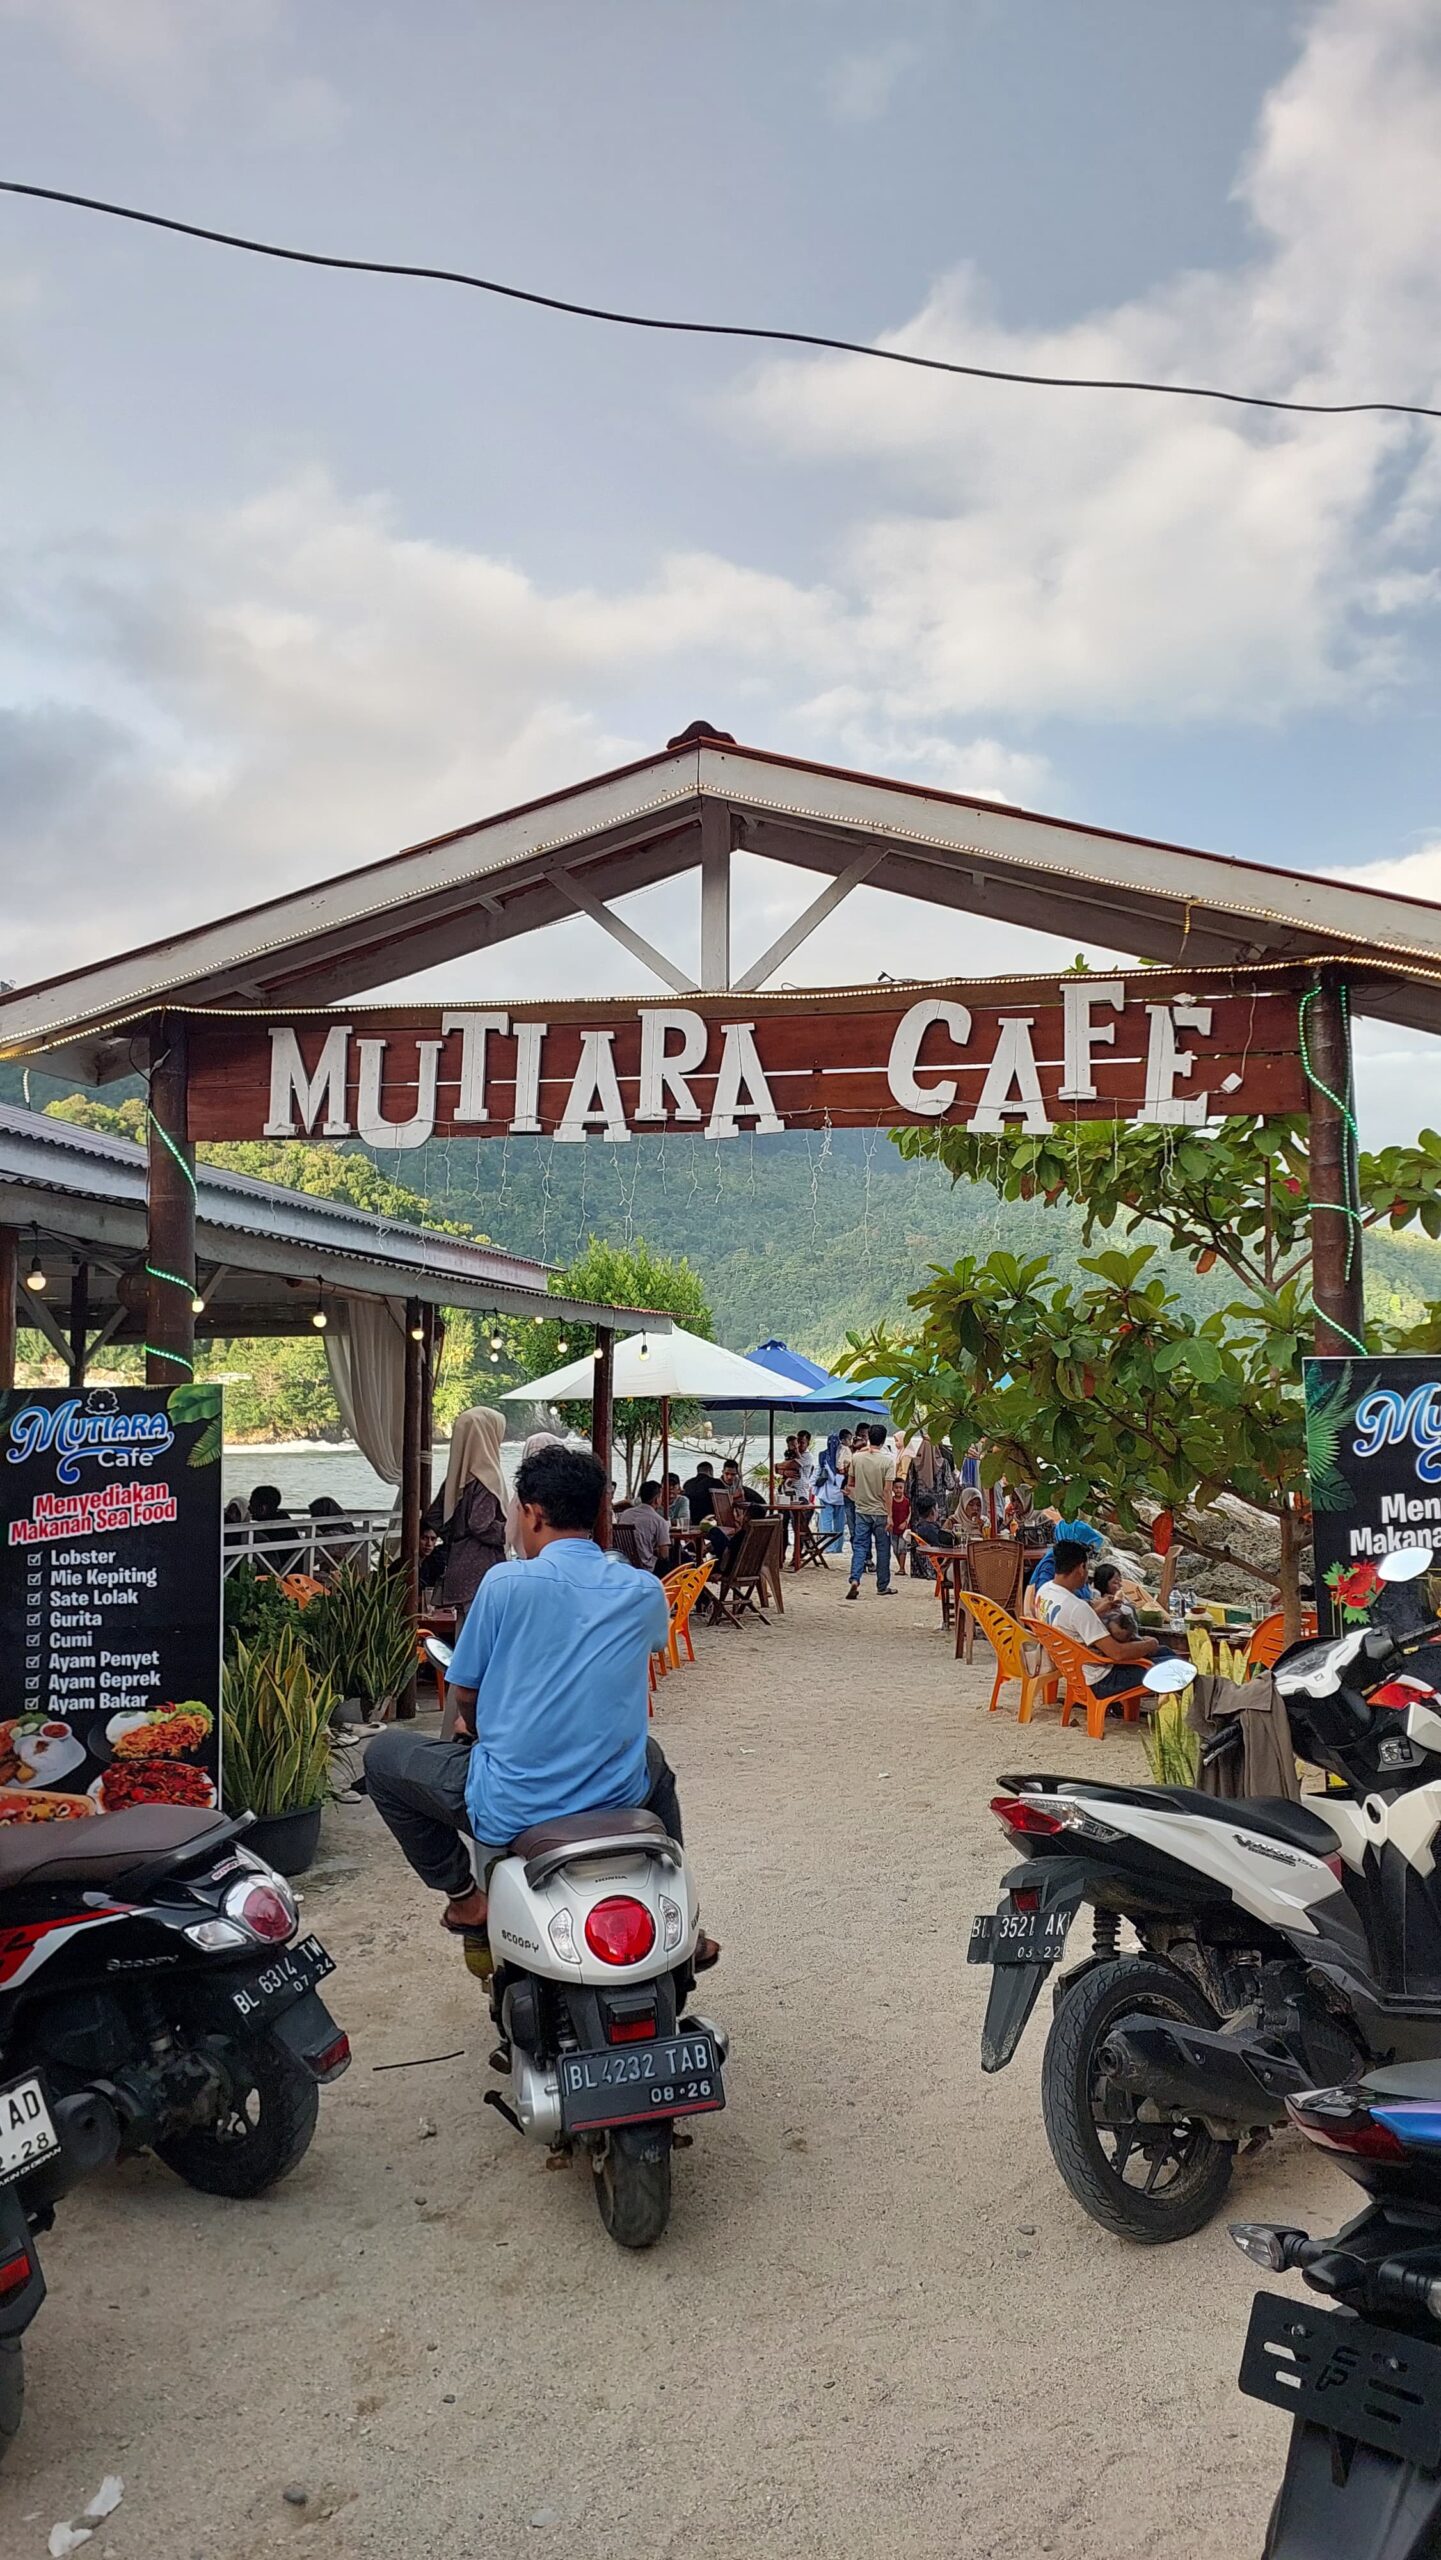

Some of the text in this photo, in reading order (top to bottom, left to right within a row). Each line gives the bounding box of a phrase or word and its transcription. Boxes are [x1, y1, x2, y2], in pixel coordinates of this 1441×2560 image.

[263, 980, 1212, 1149] MUTIARA CAFE
[7, 1399, 174, 1484] MUTIARA
[98, 1448, 154, 1468] Cafe
[34, 1481, 169, 1518] Menyediakan
[9, 1498, 177, 1545] Makanan Sea Food
[51, 1550, 116, 1565] Lobster
[50, 1567, 157, 1587] Mie Kepiting
[50, 1590, 138, 1607] Sate Lolak
[50, 1611, 102, 1627] Gurita
[50, 1631, 93, 1649] Cumi
[48, 1650, 160, 1673] Ayam Penyet
[48, 1671, 161, 1694] Ayam Geprek
[48, 1693, 149, 1715] Ayam Bakar
[1000, 1915, 1036, 1939] 3521
[1044, 1913, 1068, 1936] AK
[501, 1928, 540, 1953] SCOOPY
[1043, 1946, 1061, 1959] 22
[232, 1936, 324, 2015] BL 6314 TW
[569, 2043, 709, 2091] BL 4232 TAB
[8, 2089, 41, 2131] AD
